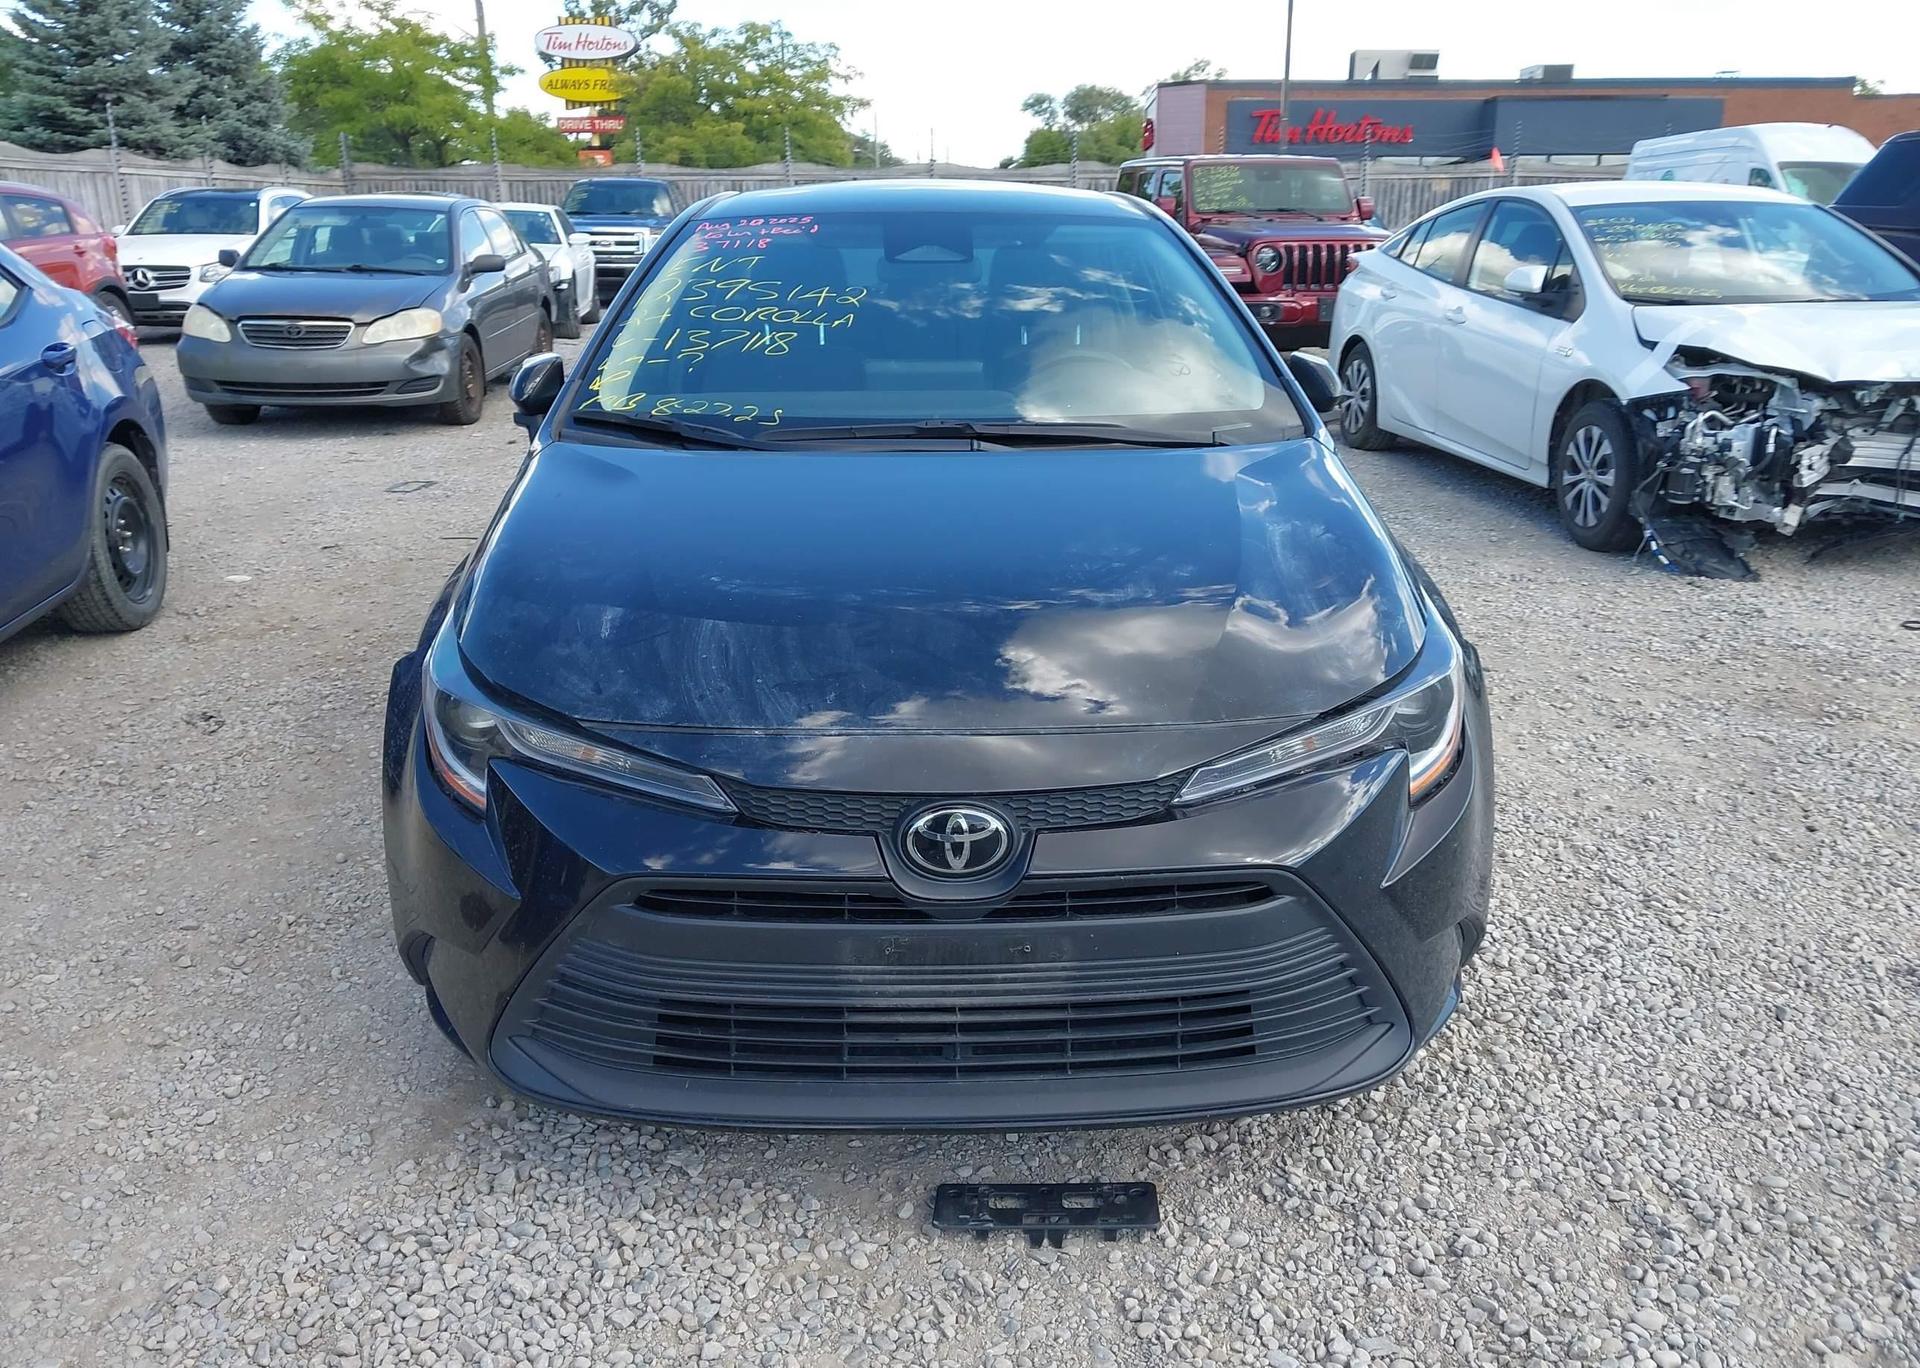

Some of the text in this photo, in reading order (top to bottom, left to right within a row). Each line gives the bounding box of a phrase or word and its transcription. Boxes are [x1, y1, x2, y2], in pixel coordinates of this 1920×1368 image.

[543, 32, 628, 51] Tim Hortons
[546, 79, 590, 90] ALWAYS
[559, 119, 624, 130] DRIVE THRU
[1304, 107, 1414, 144] Hortons
[690, 304, 855, 328] COROLLA
